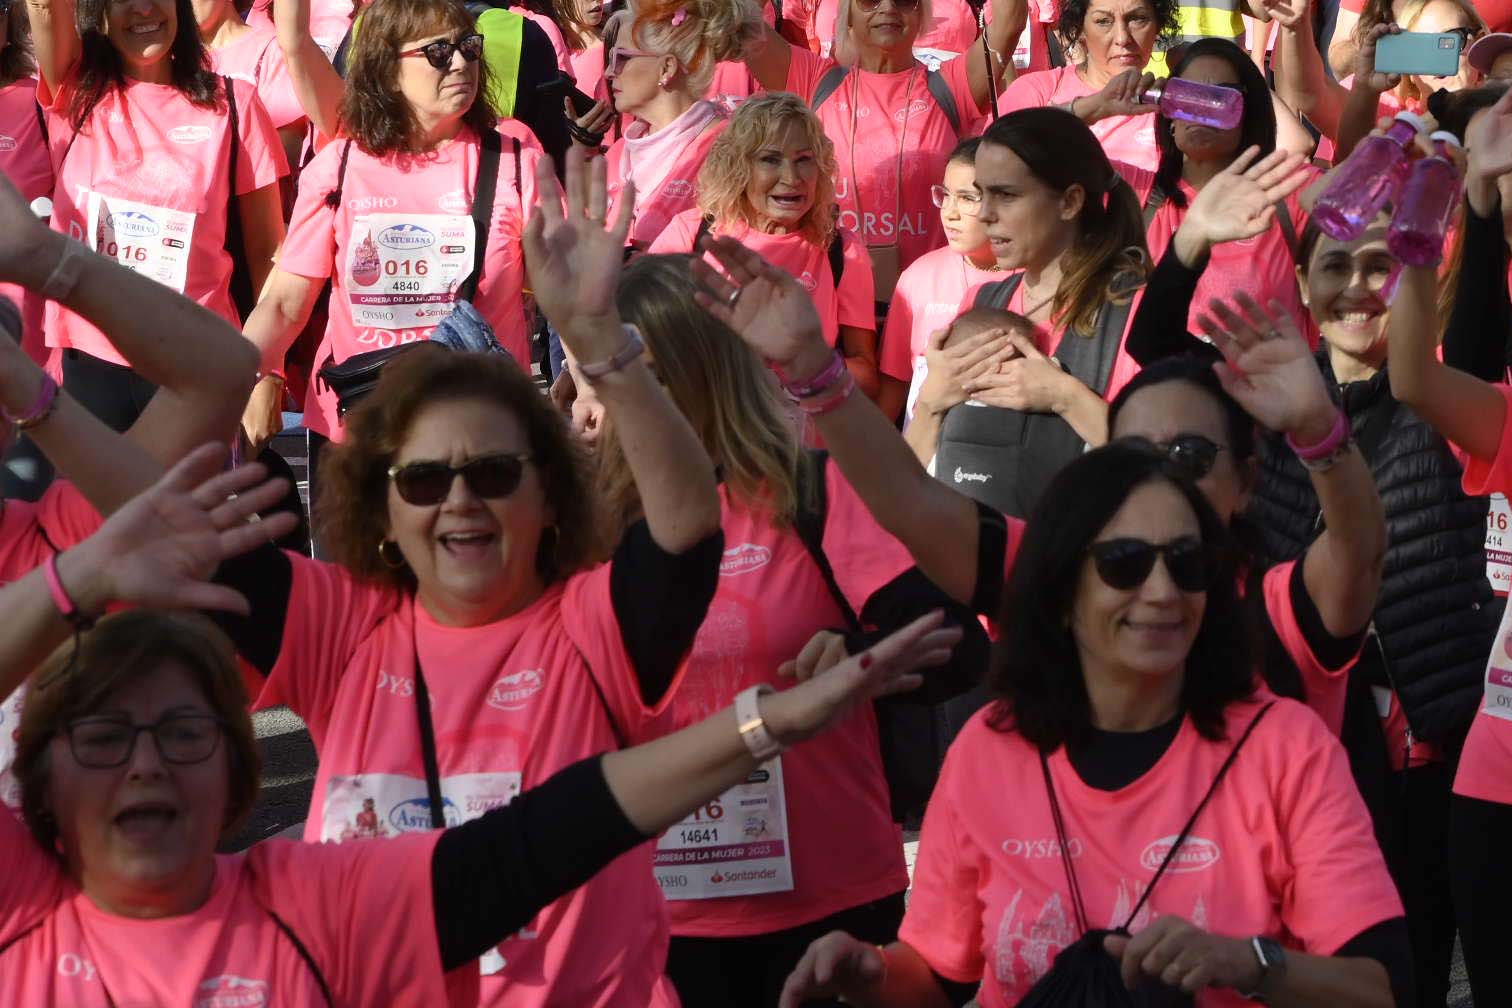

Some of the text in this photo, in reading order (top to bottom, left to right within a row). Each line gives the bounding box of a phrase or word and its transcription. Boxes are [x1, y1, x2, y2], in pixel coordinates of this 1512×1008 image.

[832, 177, 848, 199] U
[838, 209, 928, 236] ORSAL
[382, 233, 431, 245] ASTURIANA
[106, 242, 148, 262] 016
[384, 259, 429, 277] 016
[392, 281, 420, 292] 4840
[360, 295, 391, 303] CARRERA
[393, 295, 403, 303] DE
[405, 295, 414, 303] LA
[1487, 511, 1508, 530] 16
[1486, 535, 1503, 546] 414
[680, 828, 720, 844] 14641
[654, 845, 771, 863] ARRERA DE LA MUJER 2023
[657, 868, 777, 888] YSHO Santander
